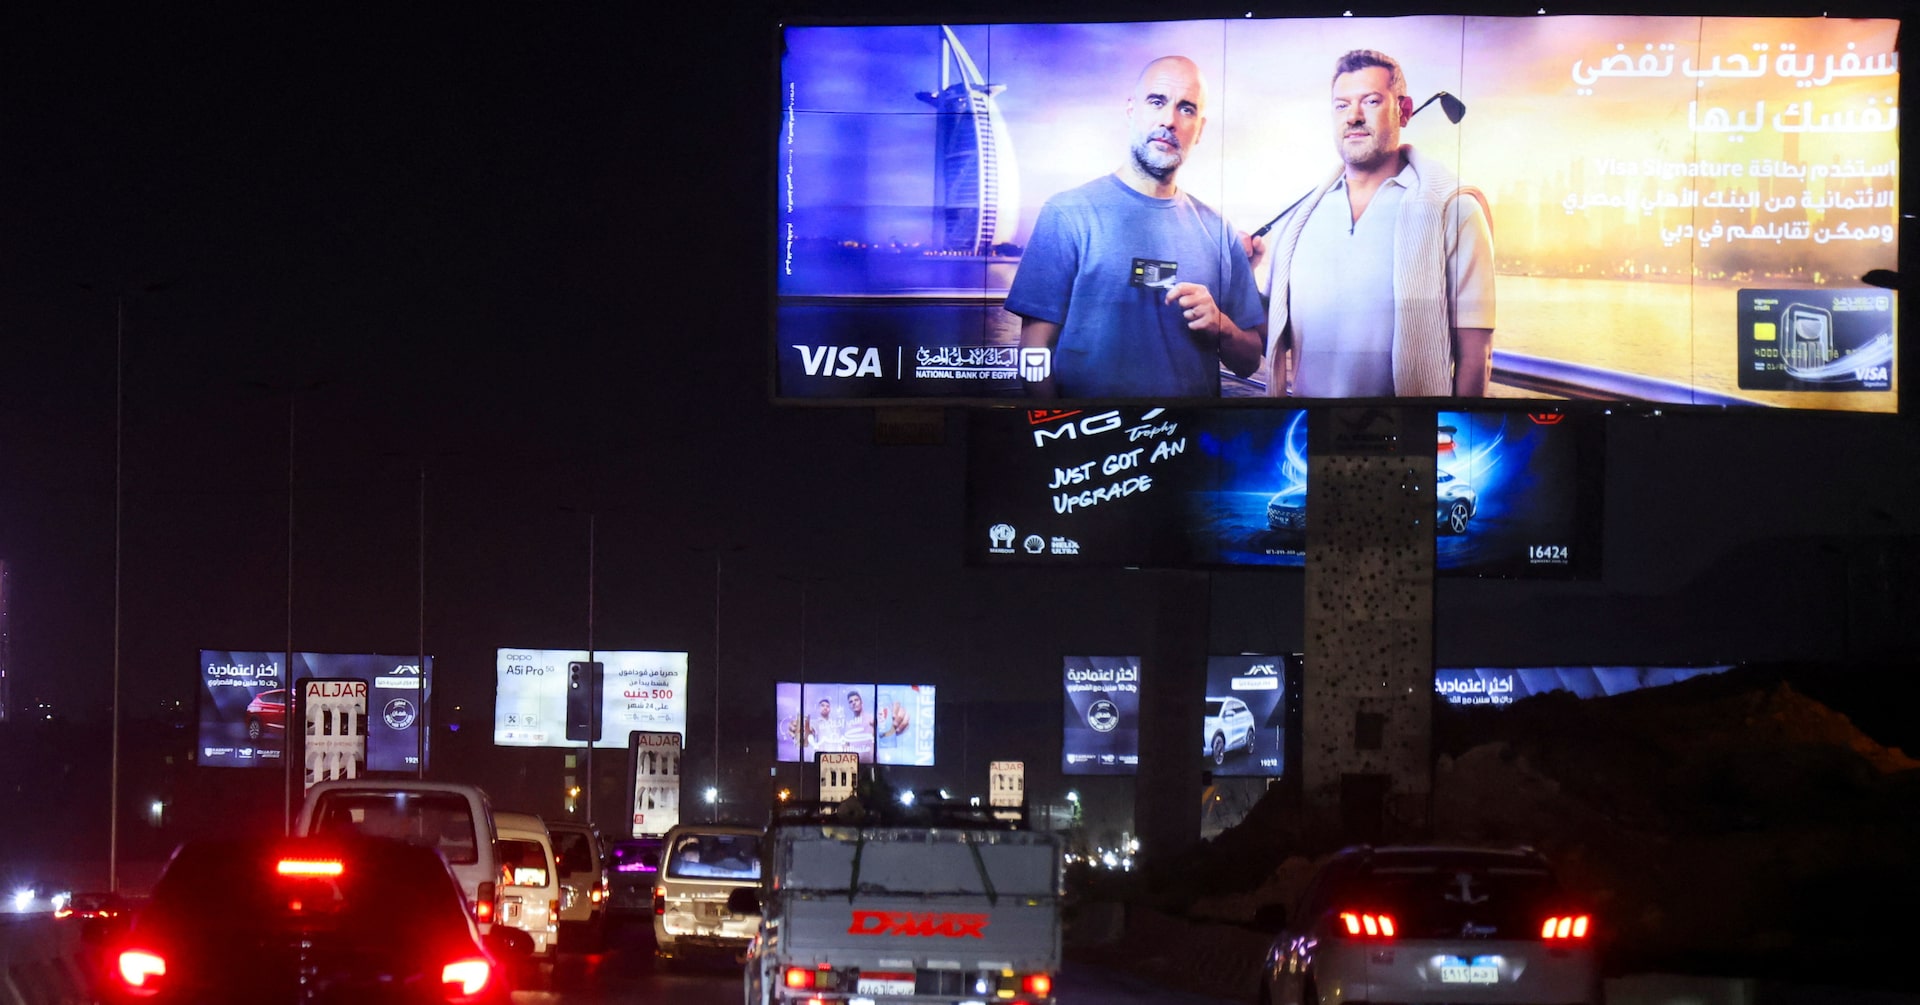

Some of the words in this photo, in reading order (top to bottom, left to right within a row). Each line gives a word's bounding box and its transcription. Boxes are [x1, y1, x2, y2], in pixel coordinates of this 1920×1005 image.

[1572, 43, 1675, 95] تفضي
[1682, 43, 1769, 87] تحب
[1775, 42, 1899, 87] سفرية
[1688, 100, 1765, 142] ليها
[1772, 95, 1899, 133] نفسك
[1595, 158, 1638, 177] Visa
[1643, 158, 1743, 180] Signature
[1750, 158, 1806, 181] بطاقة
[1810, 158, 1895, 179] استخدم
[1562, 190, 1634, 215] المصري
[1641, 187, 1698, 215] الأهلي
[1703, 191, 1760, 212] البنك
[1764, 194, 1796, 212] من
[1801, 189, 1895, 213] الائتمانية
[1661, 222, 1693, 247] دبي
[1698, 220, 1722, 247] في
[1727, 221, 1810, 244] تقابلهم
[1813, 221, 1894, 243] وممكن
[792, 345, 882, 378] VISA
[916, 370, 954, 378] NATIONAL
[955, 370, 977, 379] BANK
[979, 371, 990, 379] OF
[992, 371, 1018, 379] EGYPT
[1855, 367, 1888, 380] VISA
[1124, 420, 1178, 442] Trophy
[1048, 461, 1096, 489] JUST
[1102, 447, 1145, 478] GOT
[1150, 437, 1186, 464] AN
[1052, 474, 1153, 514] UPGRADE
[1530, 545, 1568, 559] 16424
[207, 663, 254, 678] اعتمادية
[255, 662, 278, 679] أكثر
[506, 665, 524, 676] A5i
[526, 665, 544, 676] Pro
[1067, 668, 1114, 683] اعتمادية
[1115, 666, 1137, 683] أكثر
[308, 683, 367, 698] ALJAR
[623, 687, 649, 702] جنيه
[652, 689, 673, 699] 500
[1488, 674, 1513, 695] أكثر
[640, 735, 680, 746] ALJAR
[822, 754, 857, 764] ALJAR
